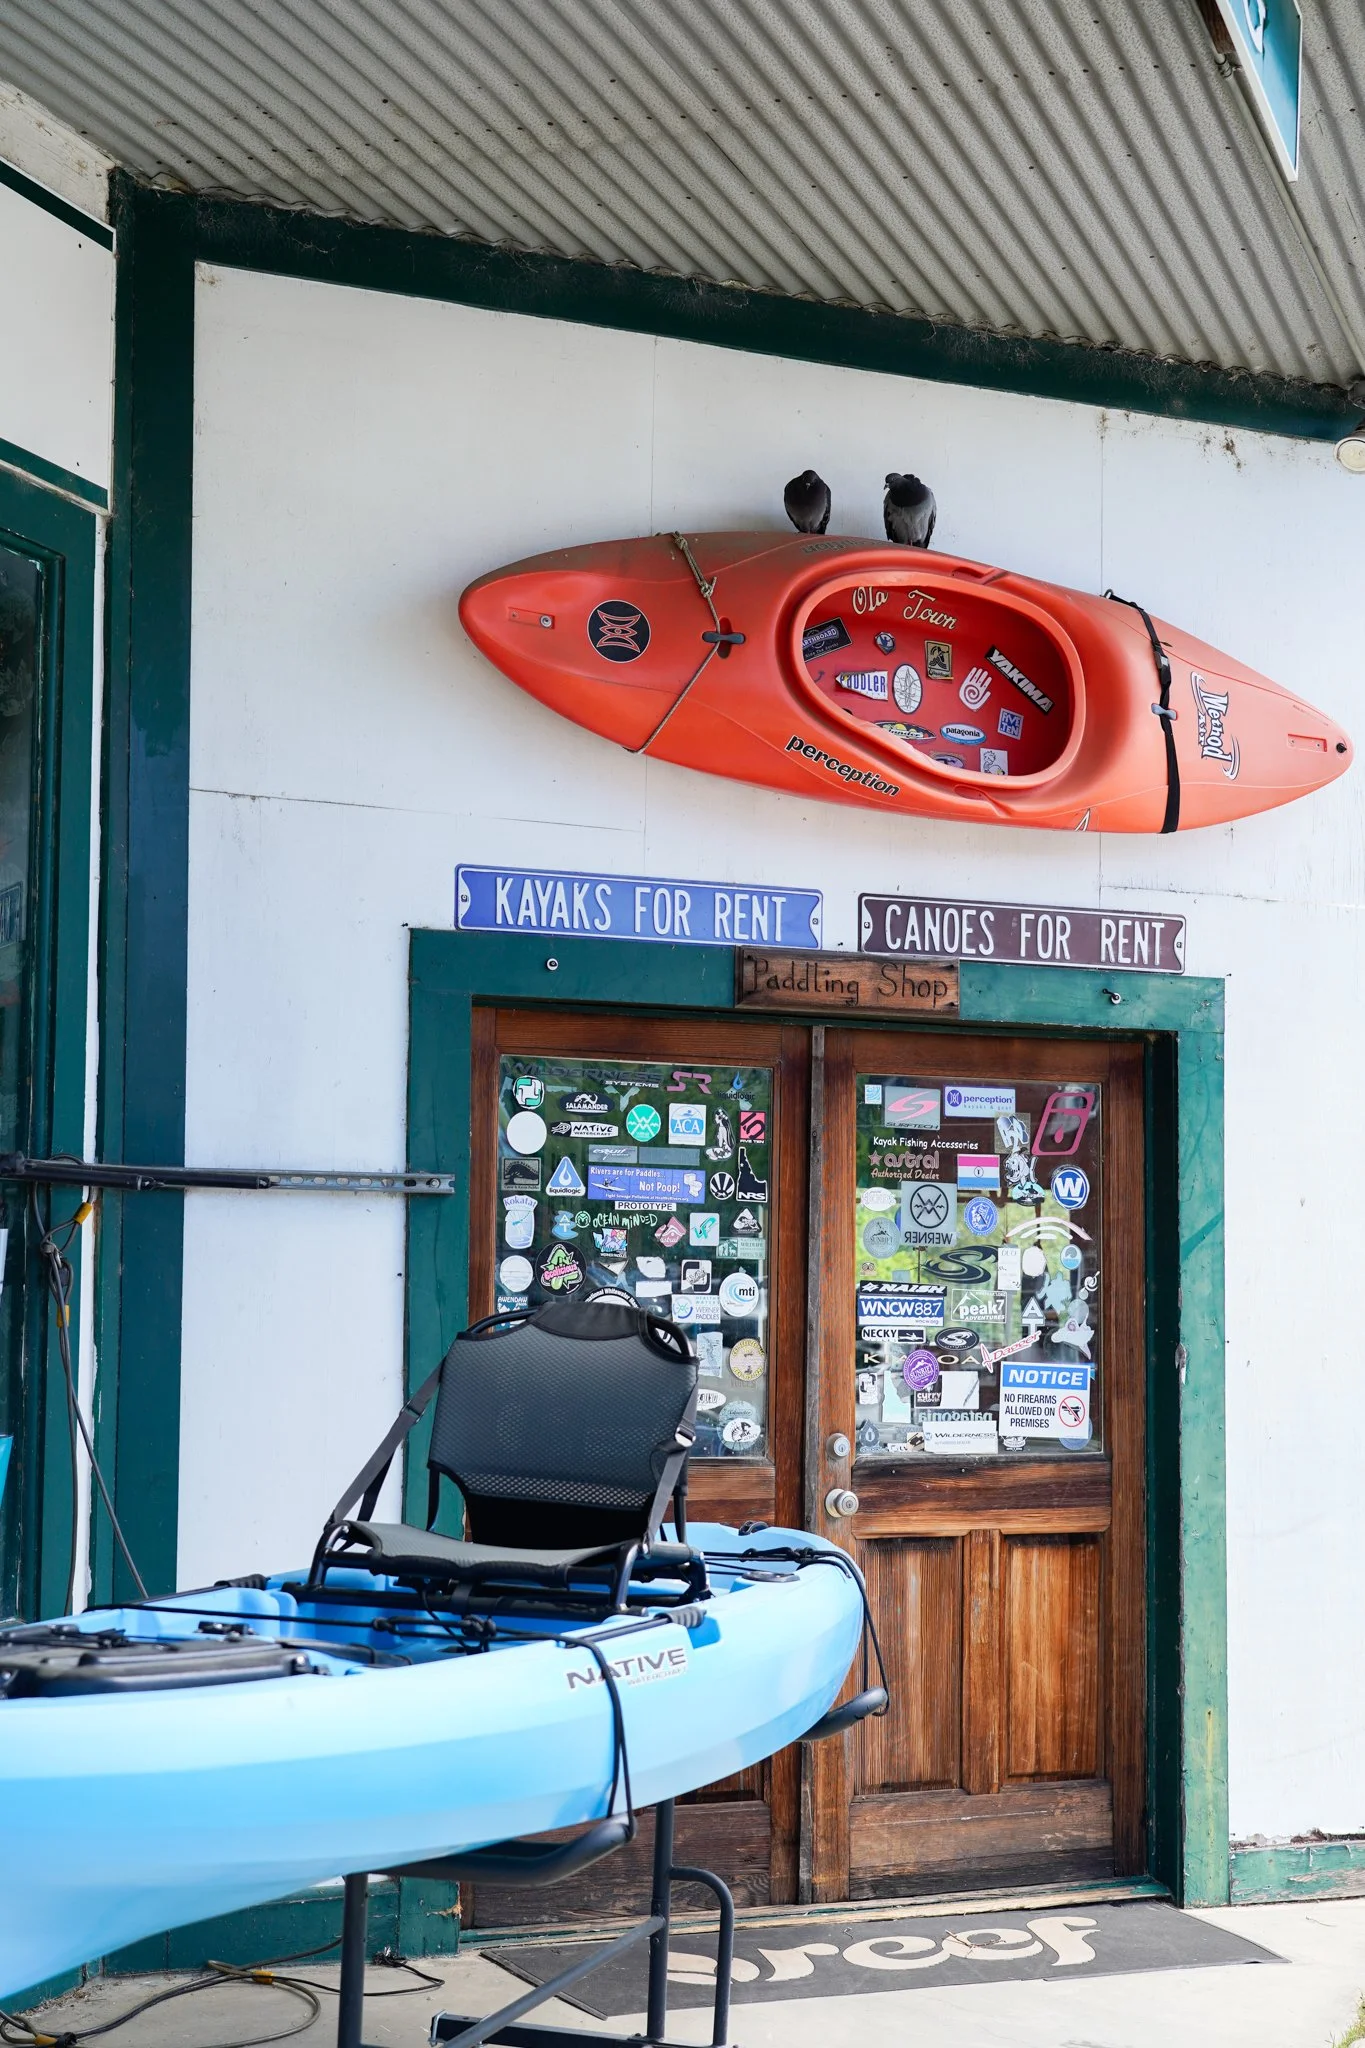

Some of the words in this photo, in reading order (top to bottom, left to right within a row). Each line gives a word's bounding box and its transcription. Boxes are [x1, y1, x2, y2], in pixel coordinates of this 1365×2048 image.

[903, 589, 957, 630] Town
[801, 627, 838, 648] ARTHBOARD
[988, 647, 1052, 712] YAKIMA
[1001, 711, 1021, 726] FIVE
[1198, 686, 1233, 762] Method
[946, 727, 981, 738] patagonia
[1000, 722, 1019, 737] TEN
[785, 734, 901, 797] perception
[495, 877, 612, 932] KAYAKS
[633, 885, 692, 937] FOR
[714, 892, 787, 943] RENT
[884, 903, 995, 956] CANOES
[1018, 914, 1072, 961] FOR
[1099, 917, 1166, 967] RENT
[751, 960, 860, 1006] Paddling
[877, 962, 949, 1009] Shop
[604, 1080, 660, 1088] SYSTEMS
[565, 1102, 609, 1111] SALAMANDER
[964, 1095, 1013, 1105] perception
[673, 1119, 701, 1134] ACA
[886, 1122, 939, 1130] SURFTECH
[873, 1136, 898, 1148] Kayak
[899, 1136, 928, 1150] Fishing
[930, 1139, 979, 1151] Accessories
[884, 1150, 940, 1170] astral
[590, 1167, 612, 1176] Rivers
[624, 1168, 634, 1176] for
[870, 1168, 912, 1182] Authorized
[914, 1169, 940, 1180] Dealer
[548, 1187, 582, 1195] liquidlogic
[639, 1181, 654, 1192] Not
[656, 1182, 680, 1194] Poop!
[738, 1191, 766, 1200] NRS
[618, 1202, 673, 1210] PROTOTYPE
[604, 1288, 630, 1300] Whitewater
[738, 1286, 756, 1296] mti
[879, 1284, 946, 1294] NAISH
[497, 1296, 528, 1304] AWENDAW
[862, 1328, 897, 1338] NECKY
[1008, 1369, 1084, 1386] NOTICE
[1004, 1393, 1016, 1403] NO
[1016, 1394, 1057, 1404] FIREARMS
[1004, 1406, 1042, 1416] ALLOWED
[1044, 1407, 1056, 1417] ON
[1010, 1418, 1050, 1428] PREMISES
[566, 1648, 686, 1690] NATIVE
[758, 1914, 1102, 1983] reef
